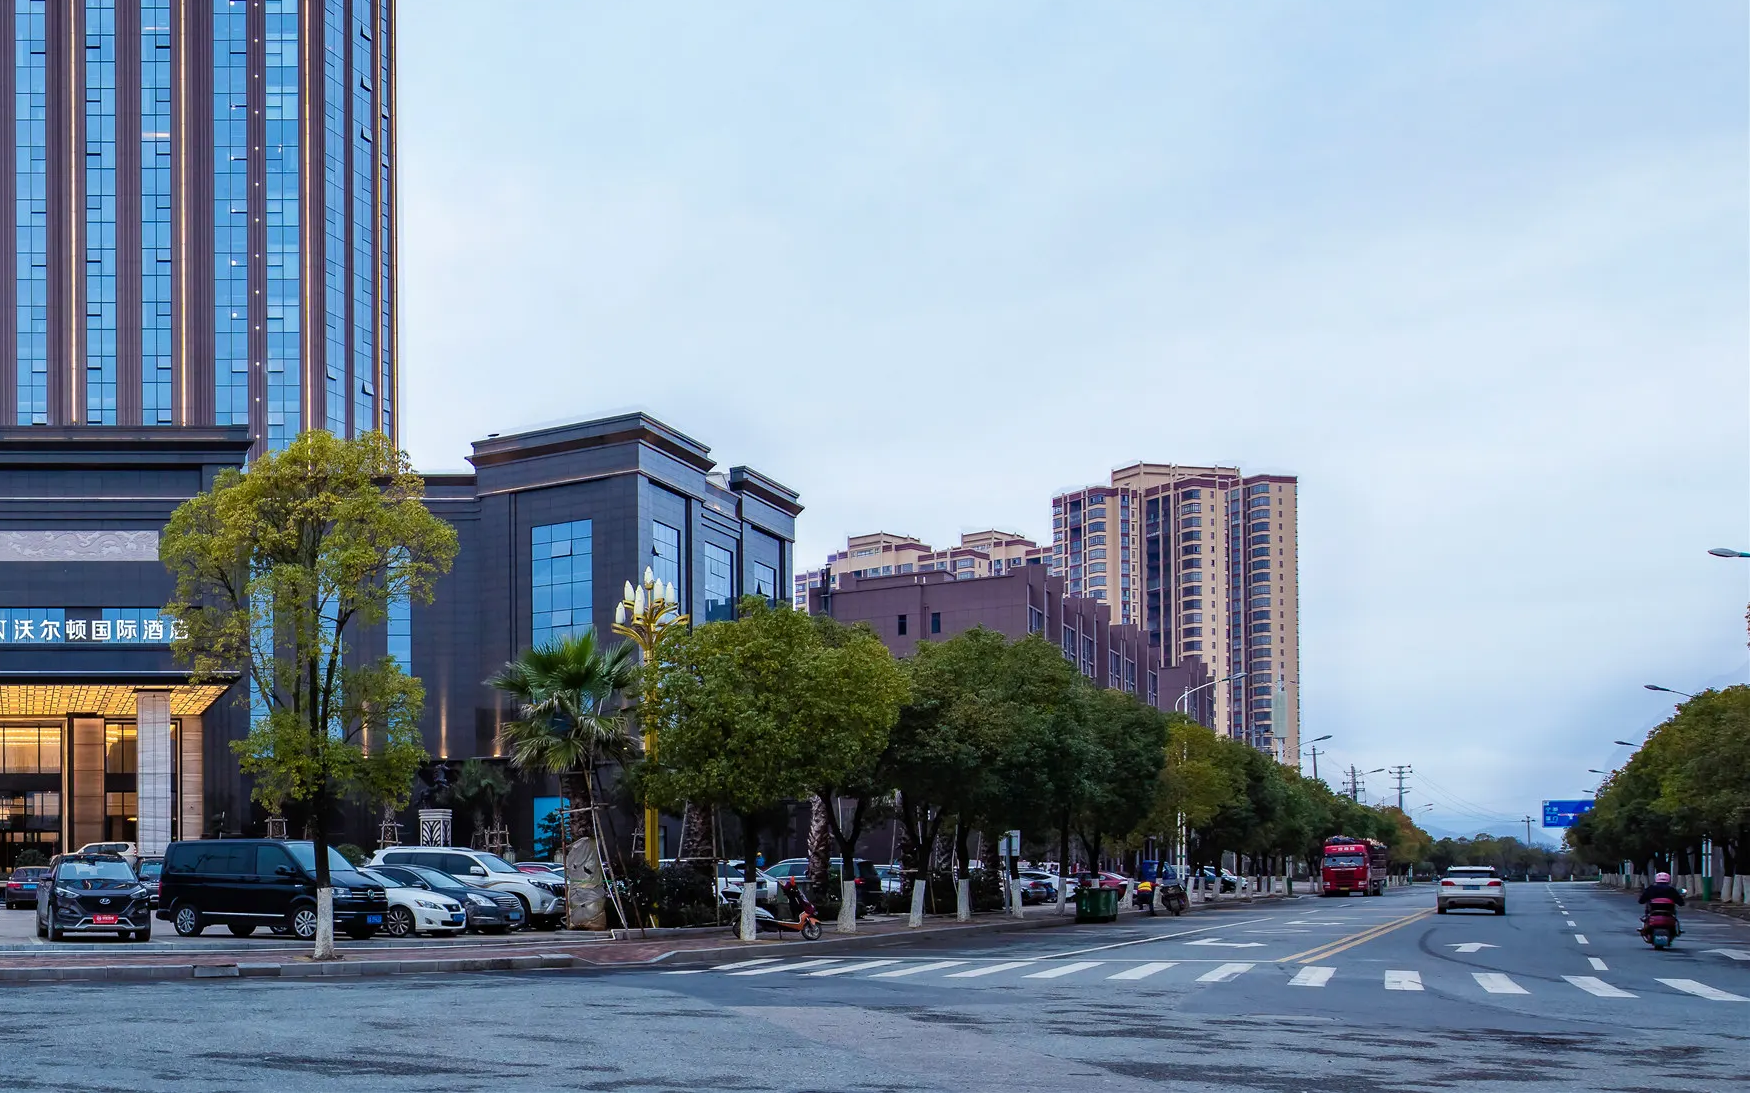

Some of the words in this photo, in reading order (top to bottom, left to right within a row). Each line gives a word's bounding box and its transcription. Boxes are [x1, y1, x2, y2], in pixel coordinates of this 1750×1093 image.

[13, 618, 189, 641] 沃尔顿国际酒店
